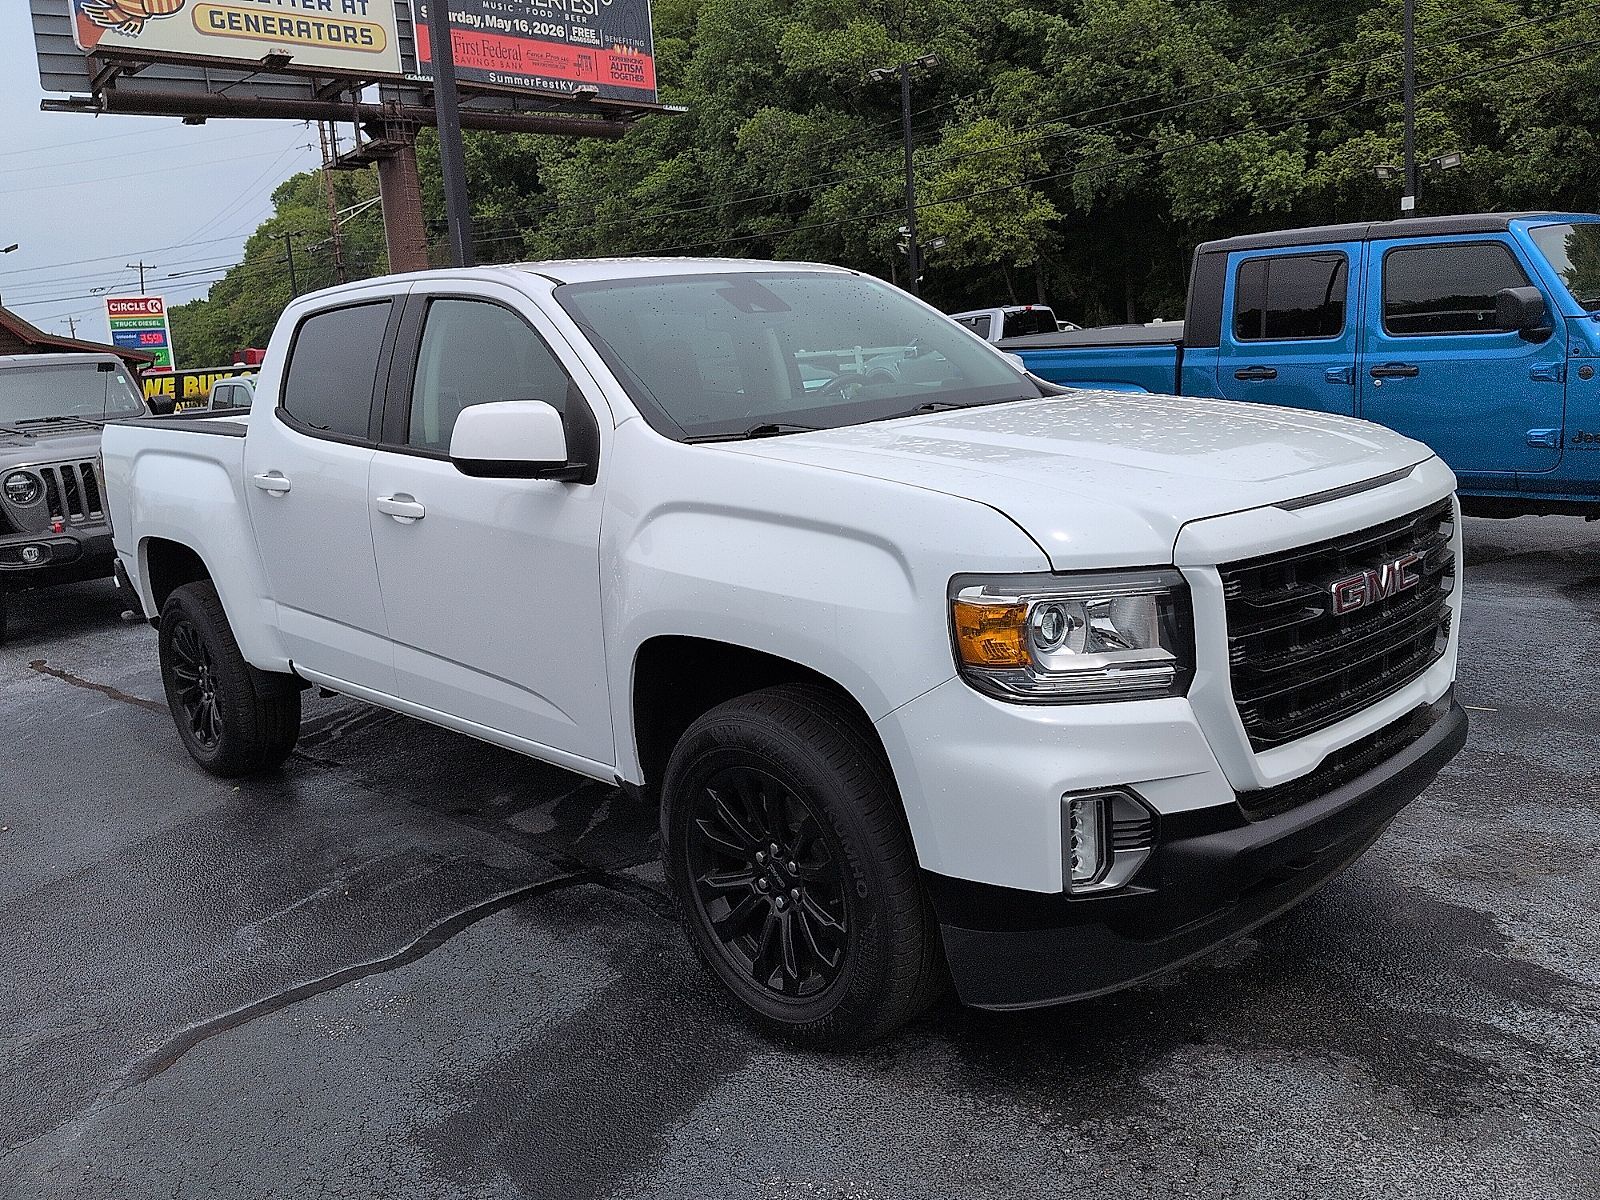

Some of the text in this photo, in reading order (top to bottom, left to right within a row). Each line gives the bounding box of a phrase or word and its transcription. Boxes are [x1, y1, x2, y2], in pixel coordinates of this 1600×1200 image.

[482, 0, 514, 12] MUSIC
[526, 7, 553, 18] FOOD
[565, 13, 587, 24] BEER
[209, 9, 373, 46] GENERATORS
[485, 14, 511, 32] May
[513, 19, 532, 35] 16,
[532, 21, 565, 38] 2026
[572, 26, 596, 38] FREE
[453, 35, 522, 61] First Federal
[569, 35, 600, 45] ADMISSION
[604, 34, 645, 47] BENEFITING
[454, 54, 496, 67] SAVINGS
[500, 60, 523, 71] BANK
[610, 61, 644, 74] AUTISM
[610, 71, 645, 83] TOGETHER
[109, 302, 146, 312] CIRCLE
[142, 376, 176, 402] WE
[1331, 553, 1420, 616] GMC
